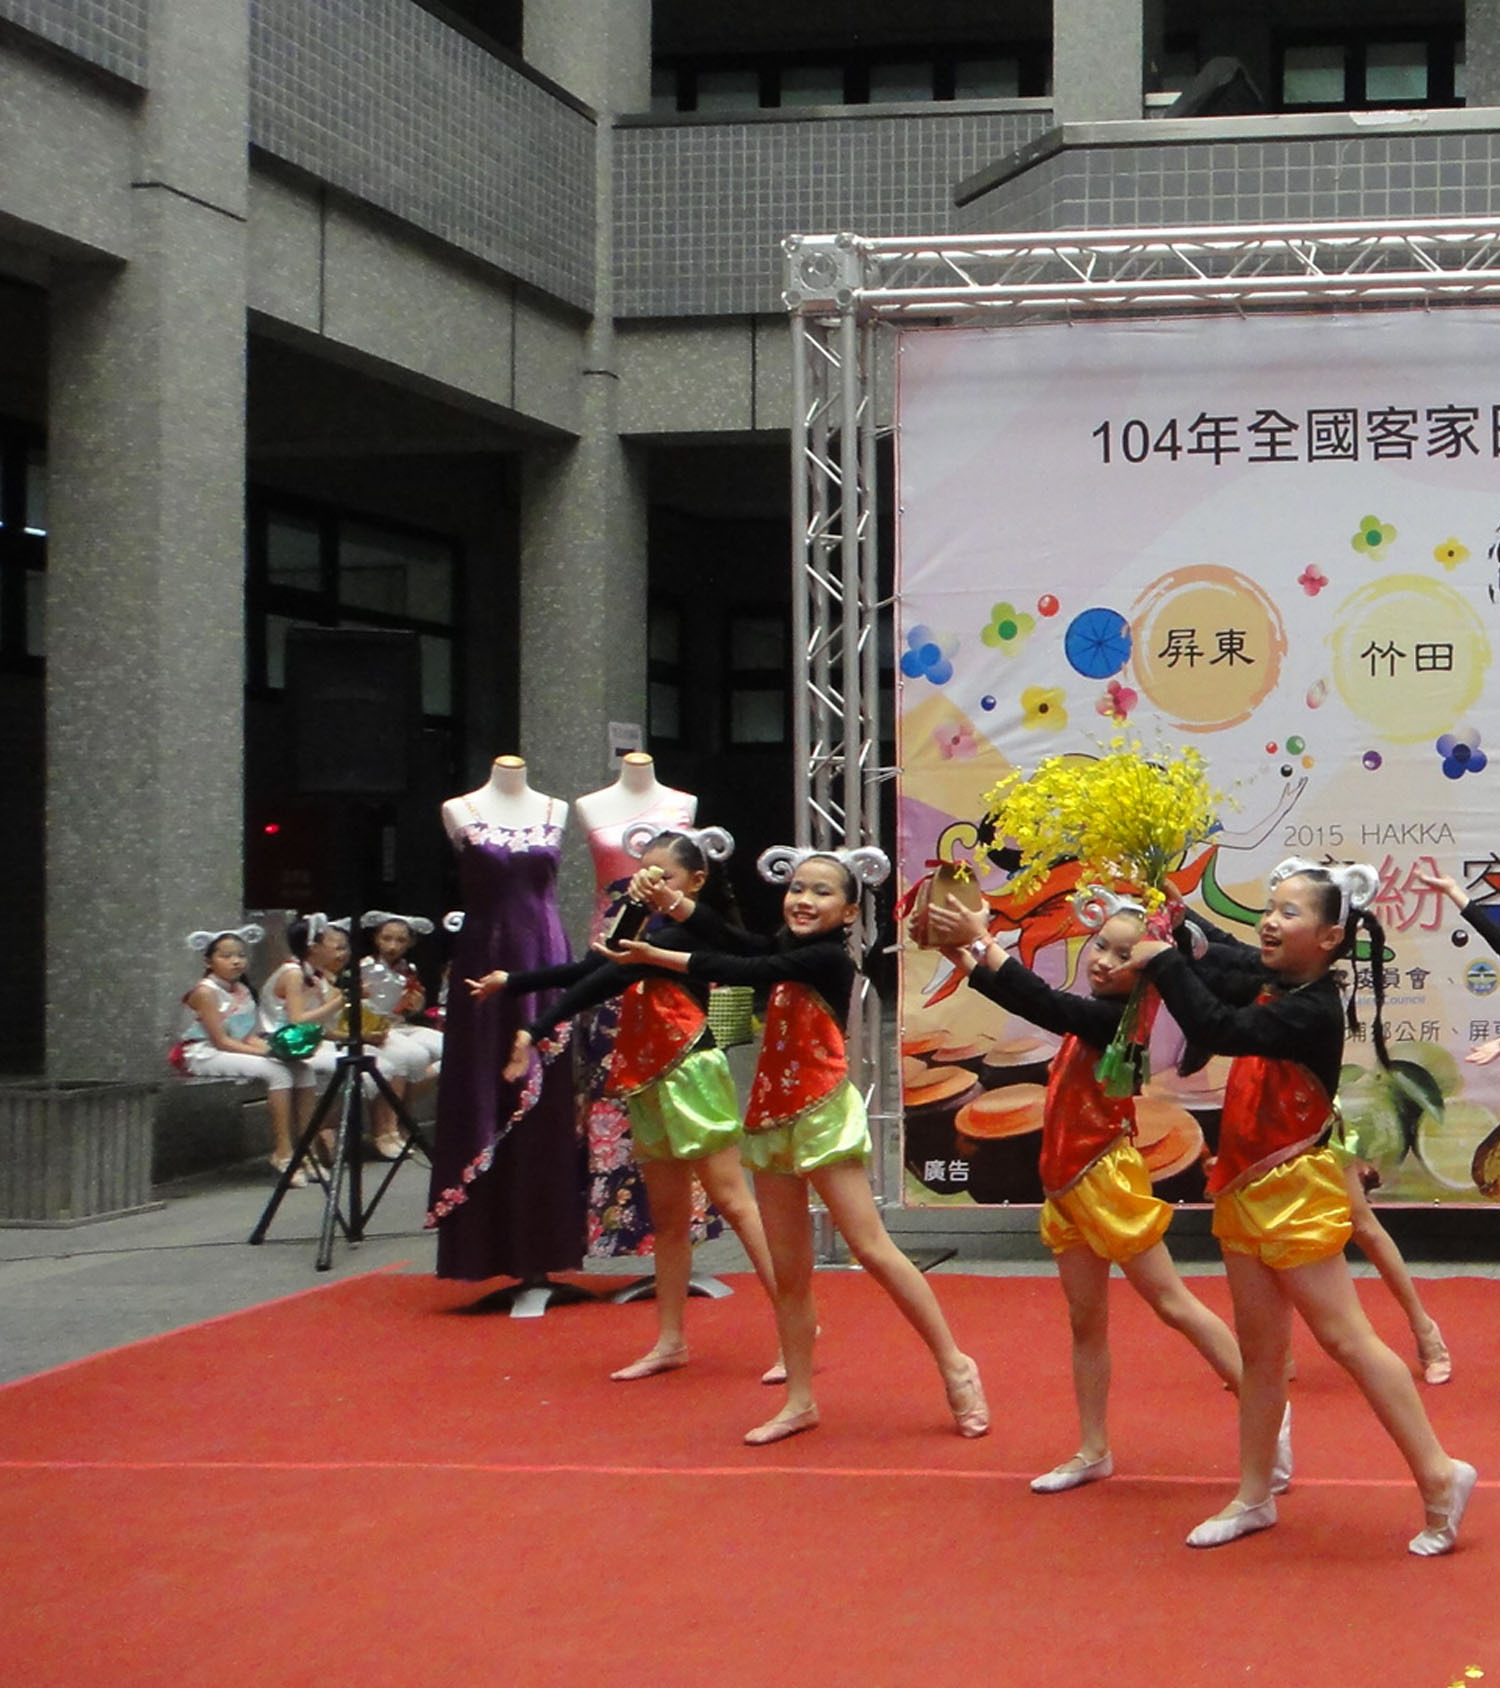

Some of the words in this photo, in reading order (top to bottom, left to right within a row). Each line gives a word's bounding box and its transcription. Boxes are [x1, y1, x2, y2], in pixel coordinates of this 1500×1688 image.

[1156, 627, 1256, 669] 屏東
[1359, 639, 1455, 678] 竹田
[1283, 824, 1344, 847] 2015
[1360, 822, 1456, 845] HAKKA
[922, 1159, 970, 1183] 廣告
